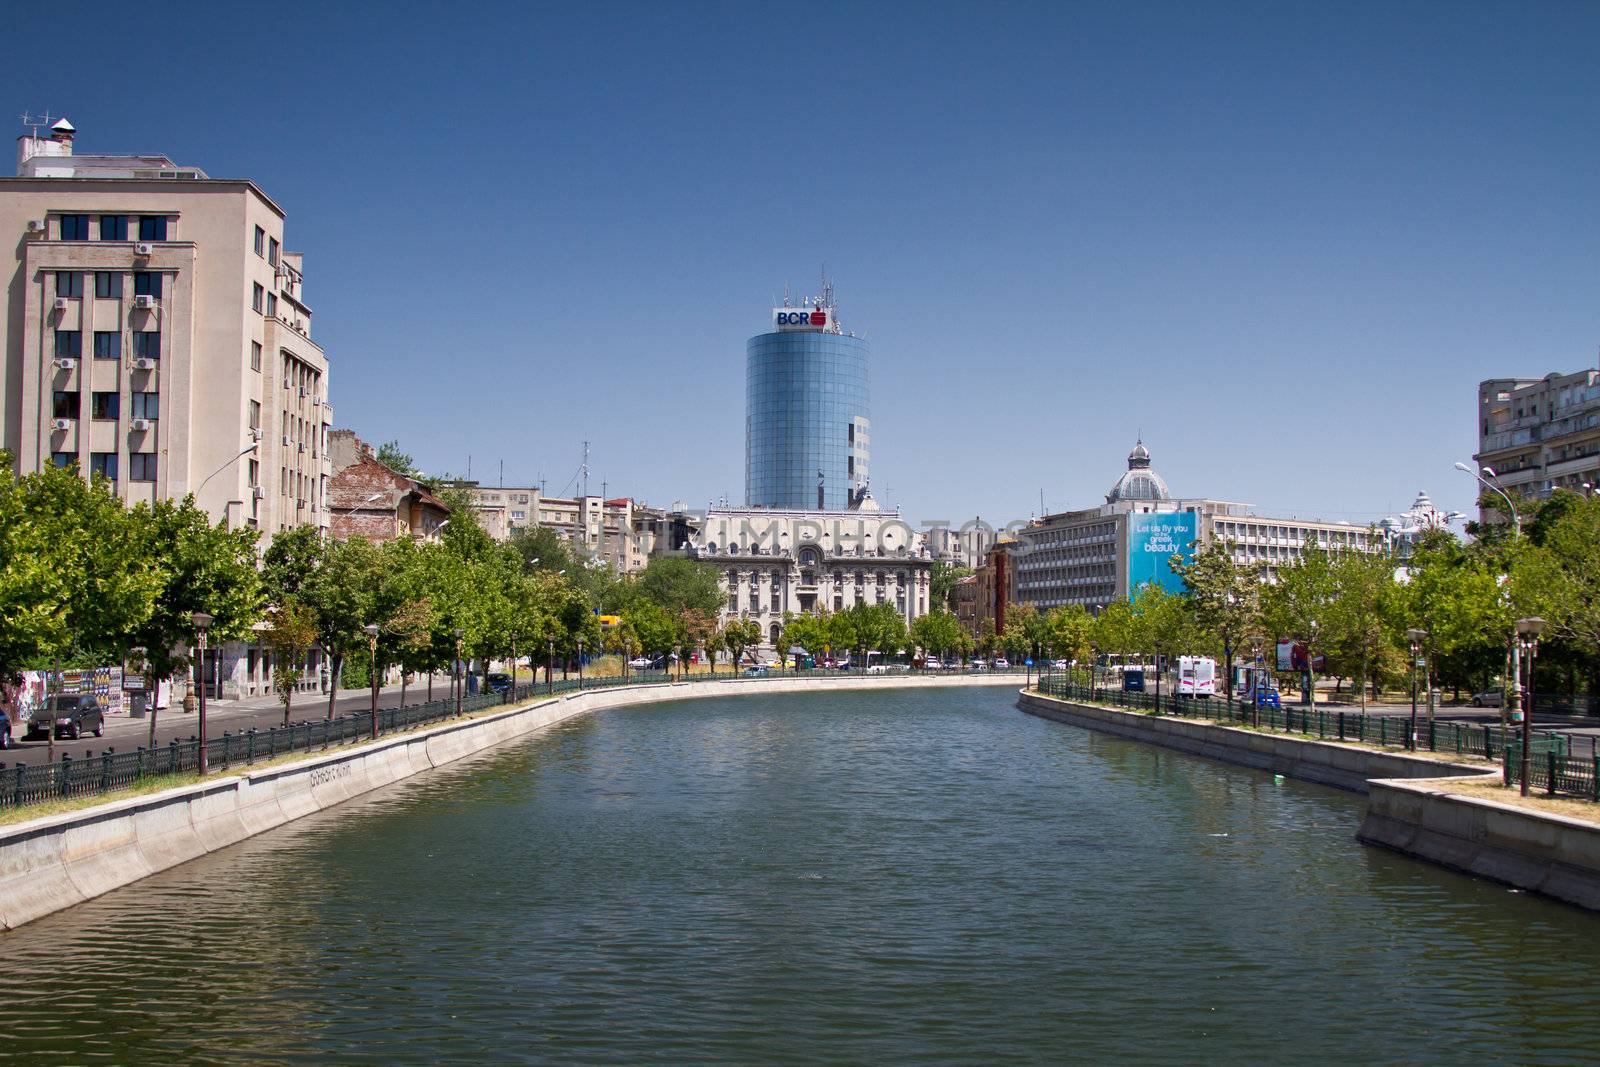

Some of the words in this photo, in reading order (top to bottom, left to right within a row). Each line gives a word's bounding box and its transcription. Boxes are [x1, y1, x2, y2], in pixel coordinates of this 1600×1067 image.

[777, 312, 809, 325] BCR
[1162, 524, 1172, 534] fly
[1174, 526, 1188, 534] you
[1150, 536, 1172, 544] greek
[1144, 543, 1180, 554] beauty
